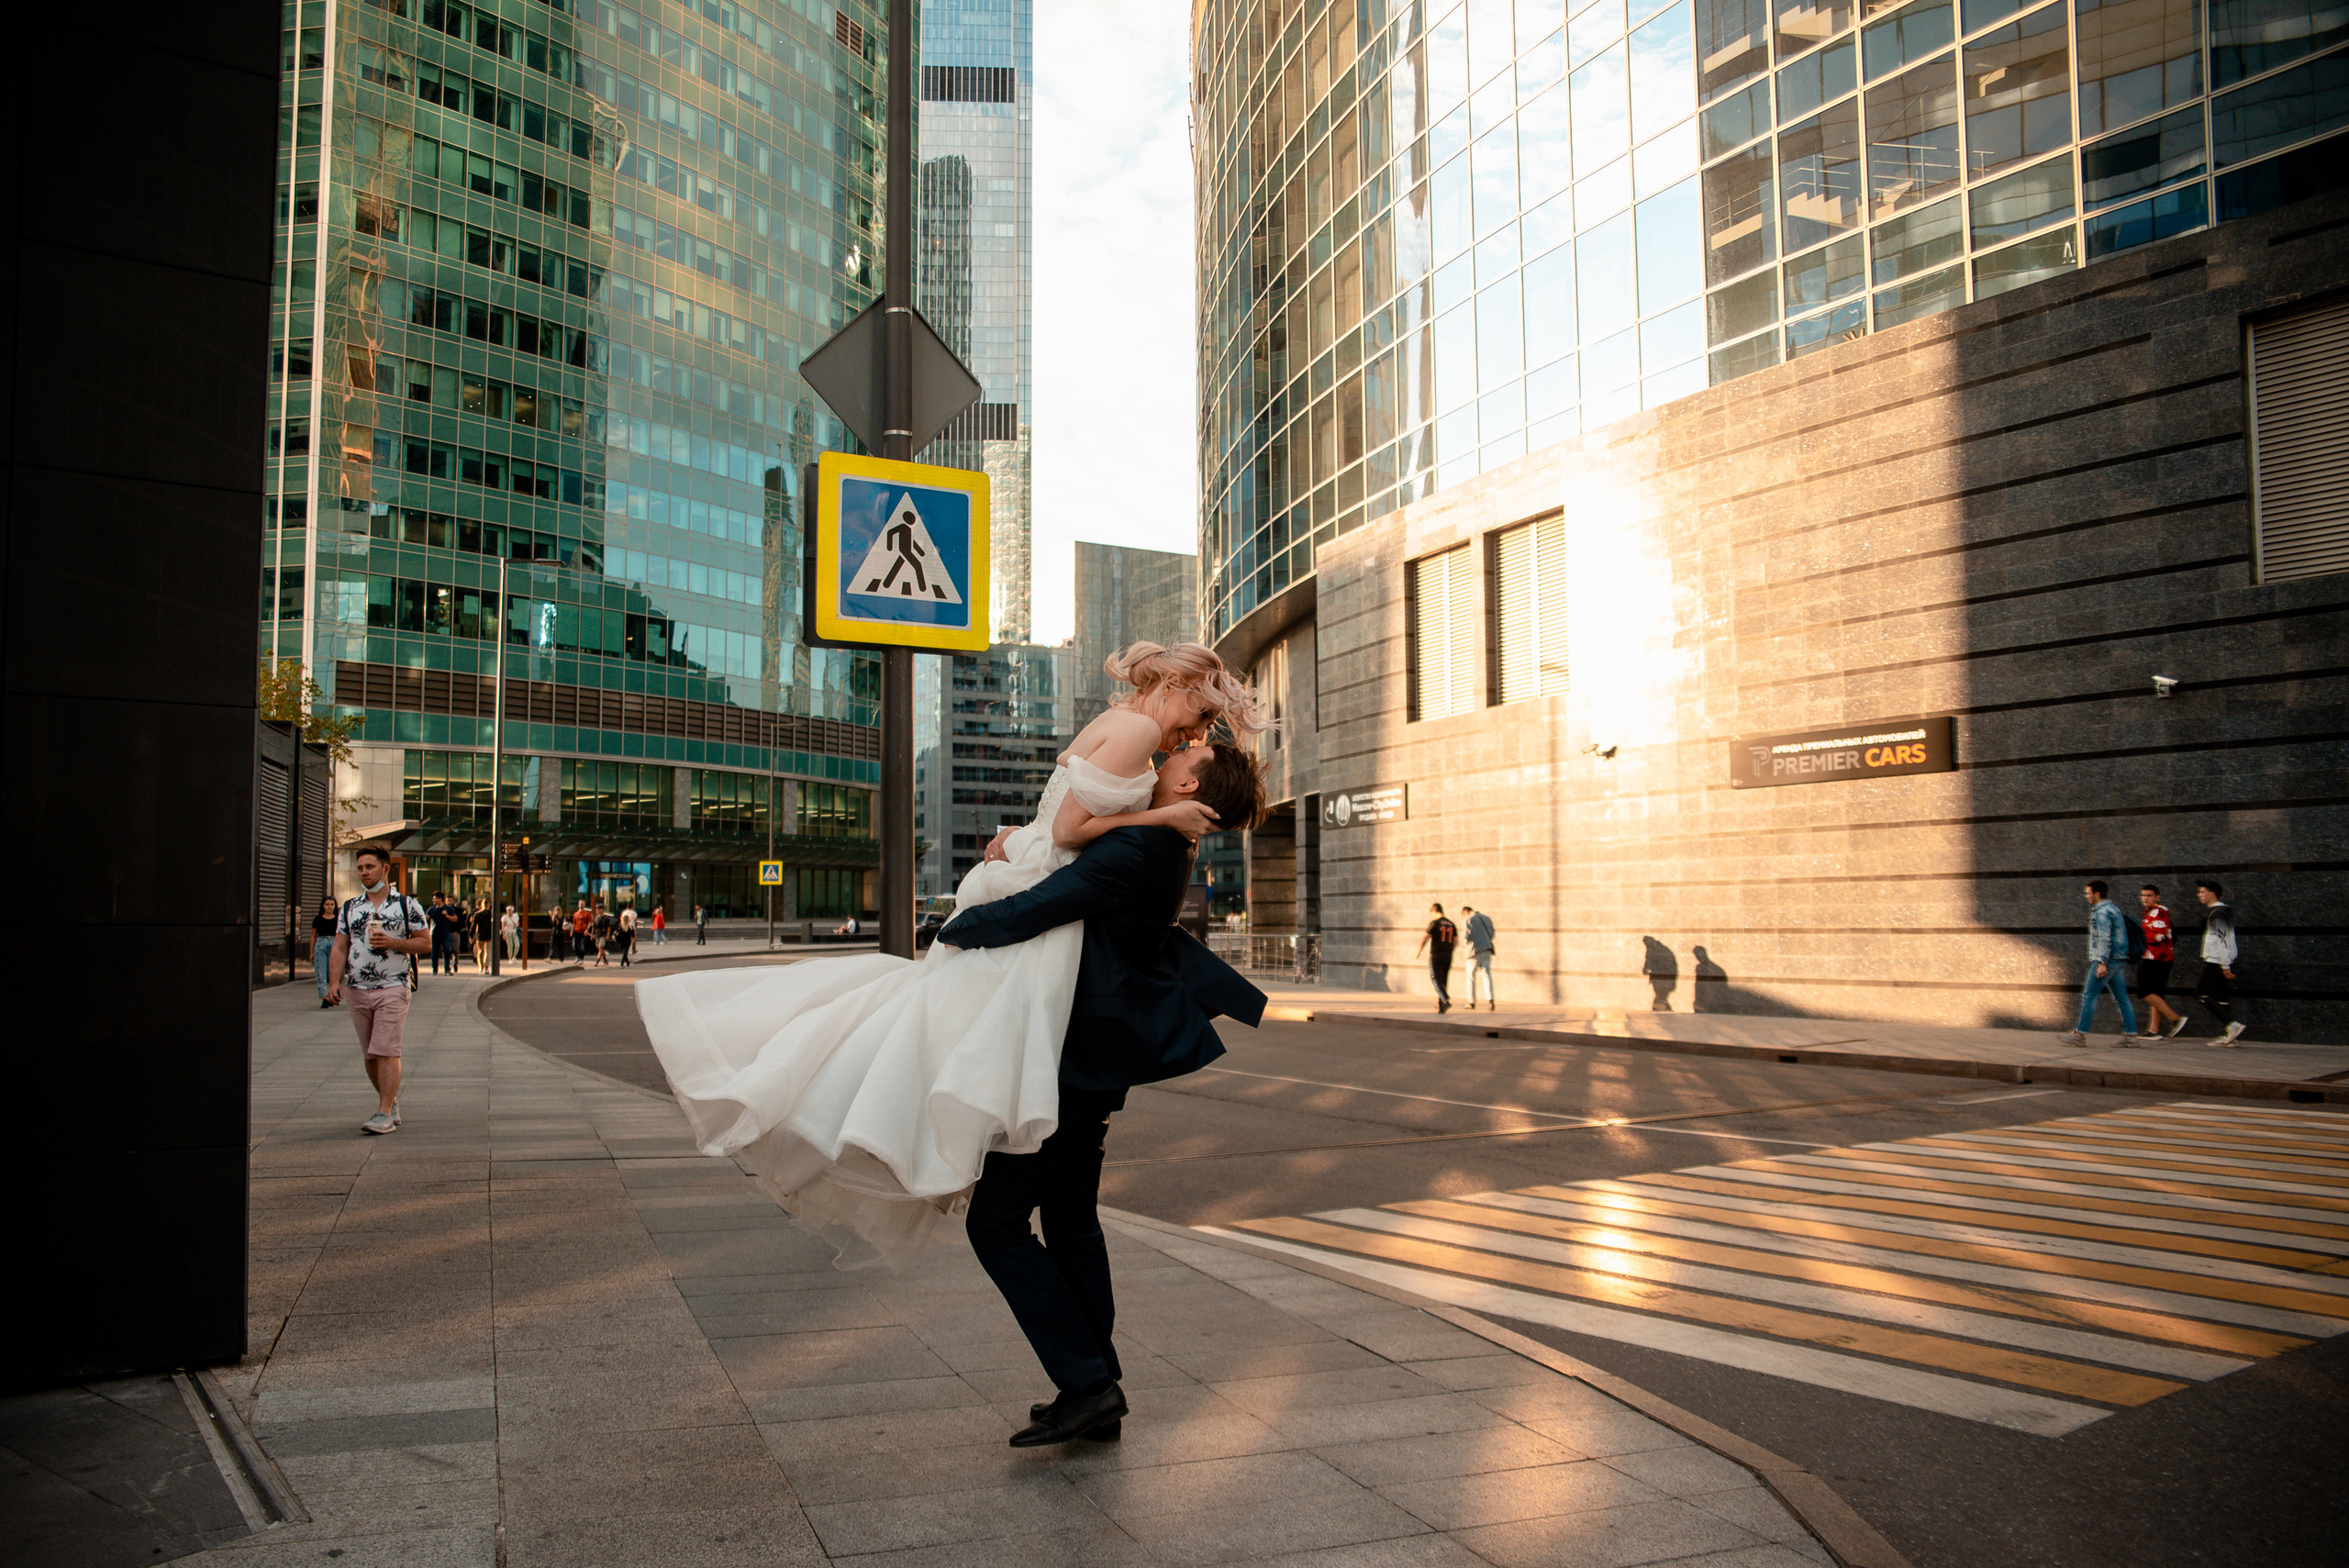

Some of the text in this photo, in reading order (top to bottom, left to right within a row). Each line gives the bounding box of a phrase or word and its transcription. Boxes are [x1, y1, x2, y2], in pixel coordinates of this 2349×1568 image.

[1772, 729, 1926, 754] АРЕНДА ПРЕМИАЛЬНЫХ АВТОМОБИЛЕЙ
[1772, 743, 1927, 776] PREMIER CARS
[1440, 926, 1453, 943] 11
